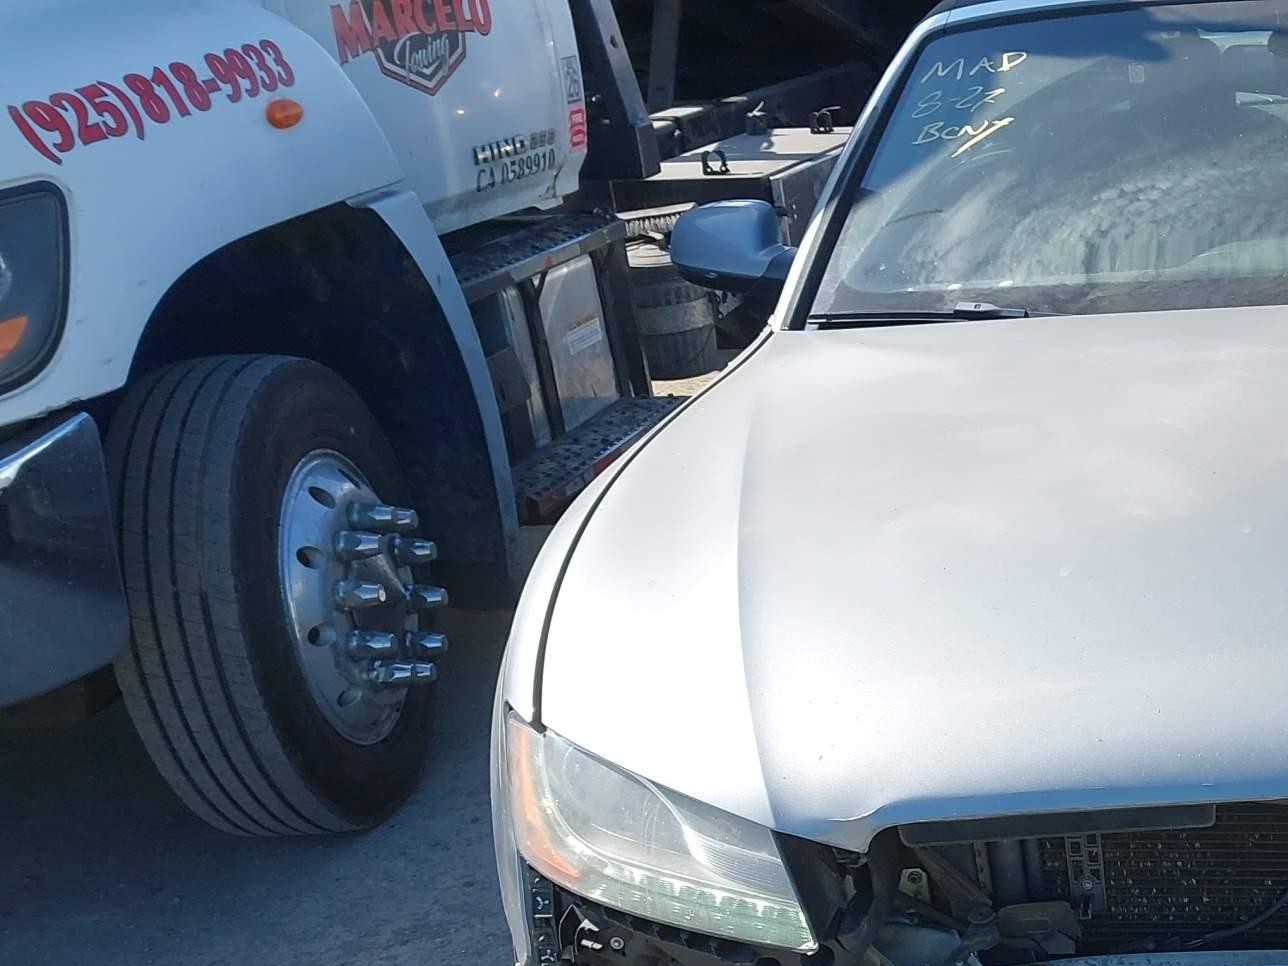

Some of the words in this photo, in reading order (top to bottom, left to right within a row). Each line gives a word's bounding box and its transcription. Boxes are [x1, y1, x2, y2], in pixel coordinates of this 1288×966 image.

[920, 51, 1028, 84] MAD
[8, 39, 295, 166] (925)818-9933
[476, 166, 496, 193] CA
